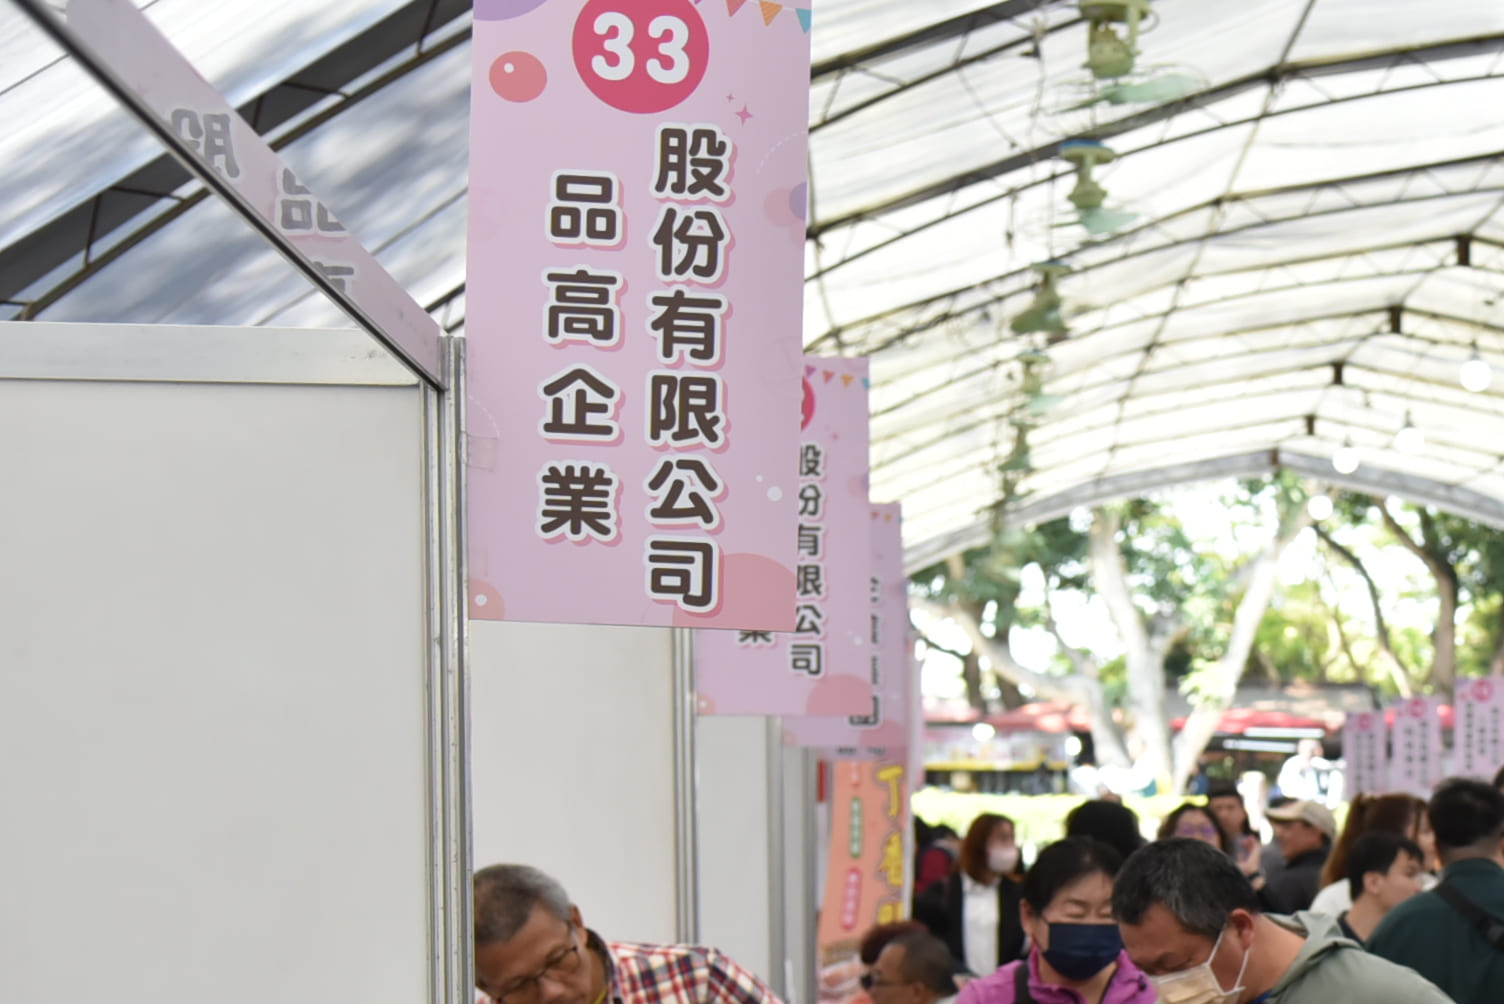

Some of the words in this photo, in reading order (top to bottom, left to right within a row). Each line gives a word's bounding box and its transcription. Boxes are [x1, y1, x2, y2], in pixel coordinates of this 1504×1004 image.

[591, 12, 690, 84] 33
[541, 174, 617, 536] 品高企業
[648, 127, 727, 607] 股份有限公司
